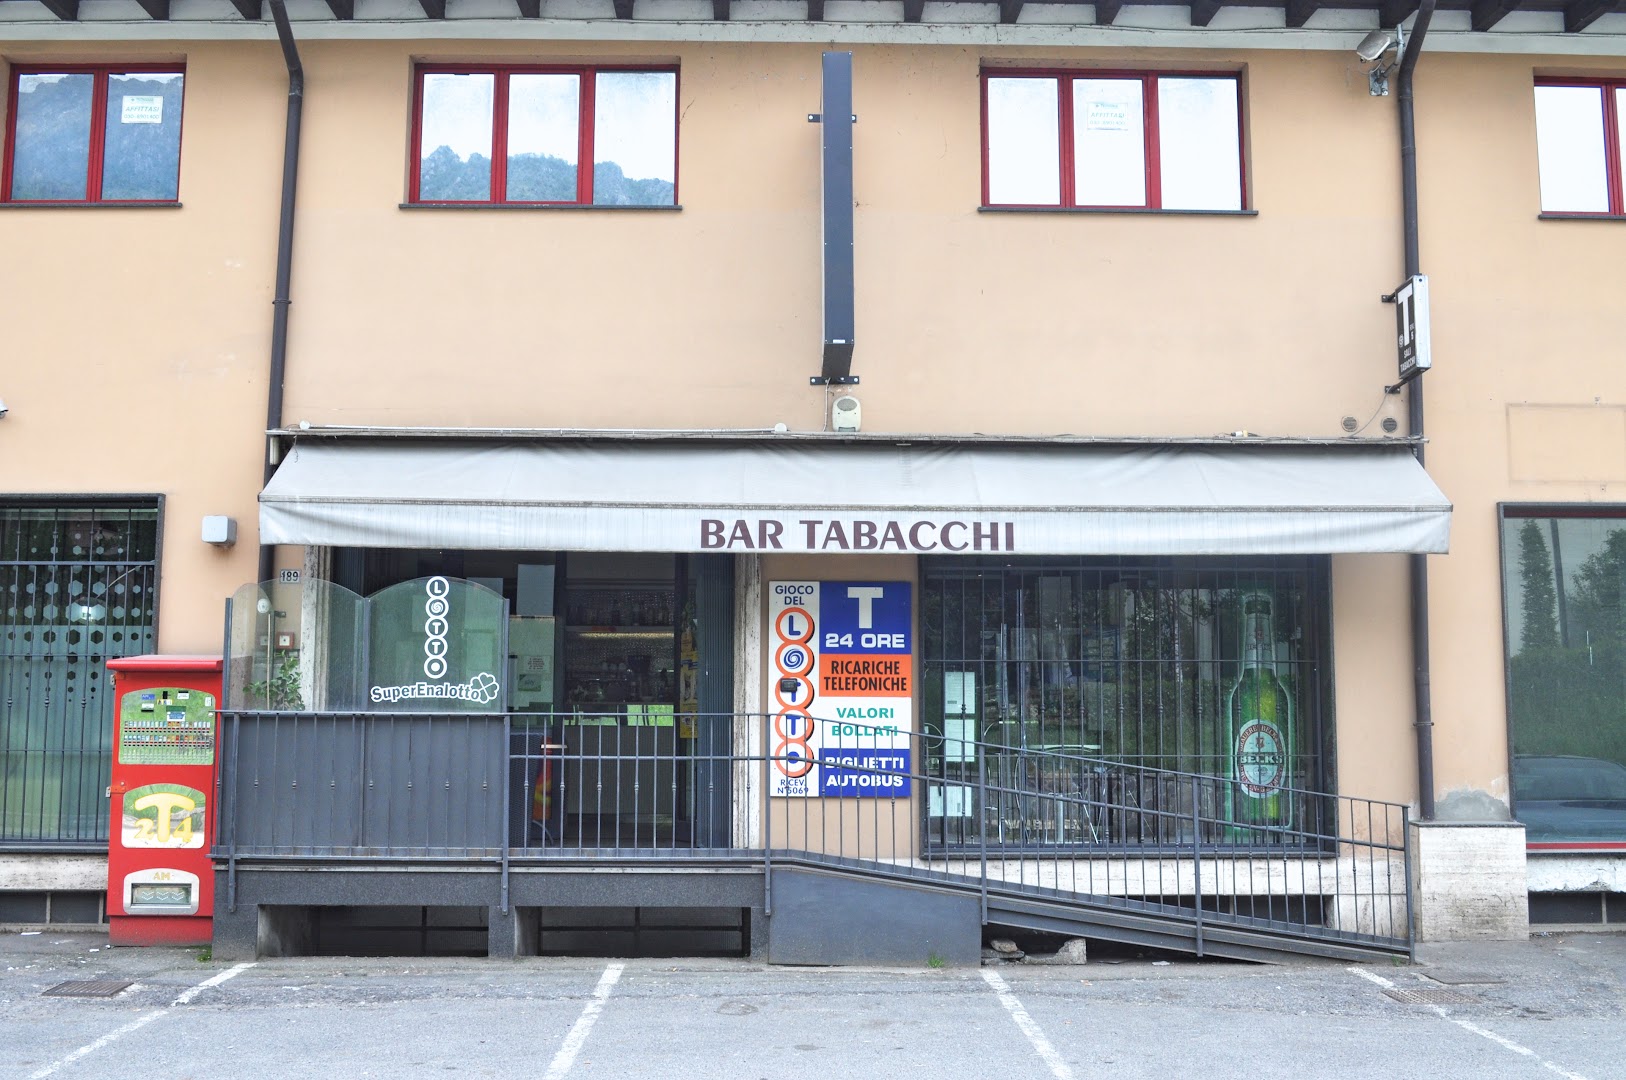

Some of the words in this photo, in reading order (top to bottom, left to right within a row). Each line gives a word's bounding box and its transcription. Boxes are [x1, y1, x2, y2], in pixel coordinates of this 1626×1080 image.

[1397, 282, 1413, 347] T
[700, 519, 784, 549] BAR
[799, 520, 1015, 552] TABACCHI
[281, 571, 299, 582] 189
[775, 585, 814, 595] GIOCO
[784, 596, 805, 605] DEL
[847, 587, 884, 628] T
[825, 633, 853, 648] 24
[860, 633, 905, 648] ORE
[831, 661, 900, 675] RICARICHE
[824, 677, 907, 691] TELEFONICHE
[370, 682, 480, 702] SuperEnalotto
[836, 708, 894, 718] VALORI
[831, 725, 898, 736] BOLLATI
[825, 757, 905, 769] BIGLIETTI
[826, 775, 904, 787] AUTOBUS
[777, 787, 809, 795] N5069
[153, 872, 171, 881] AM
